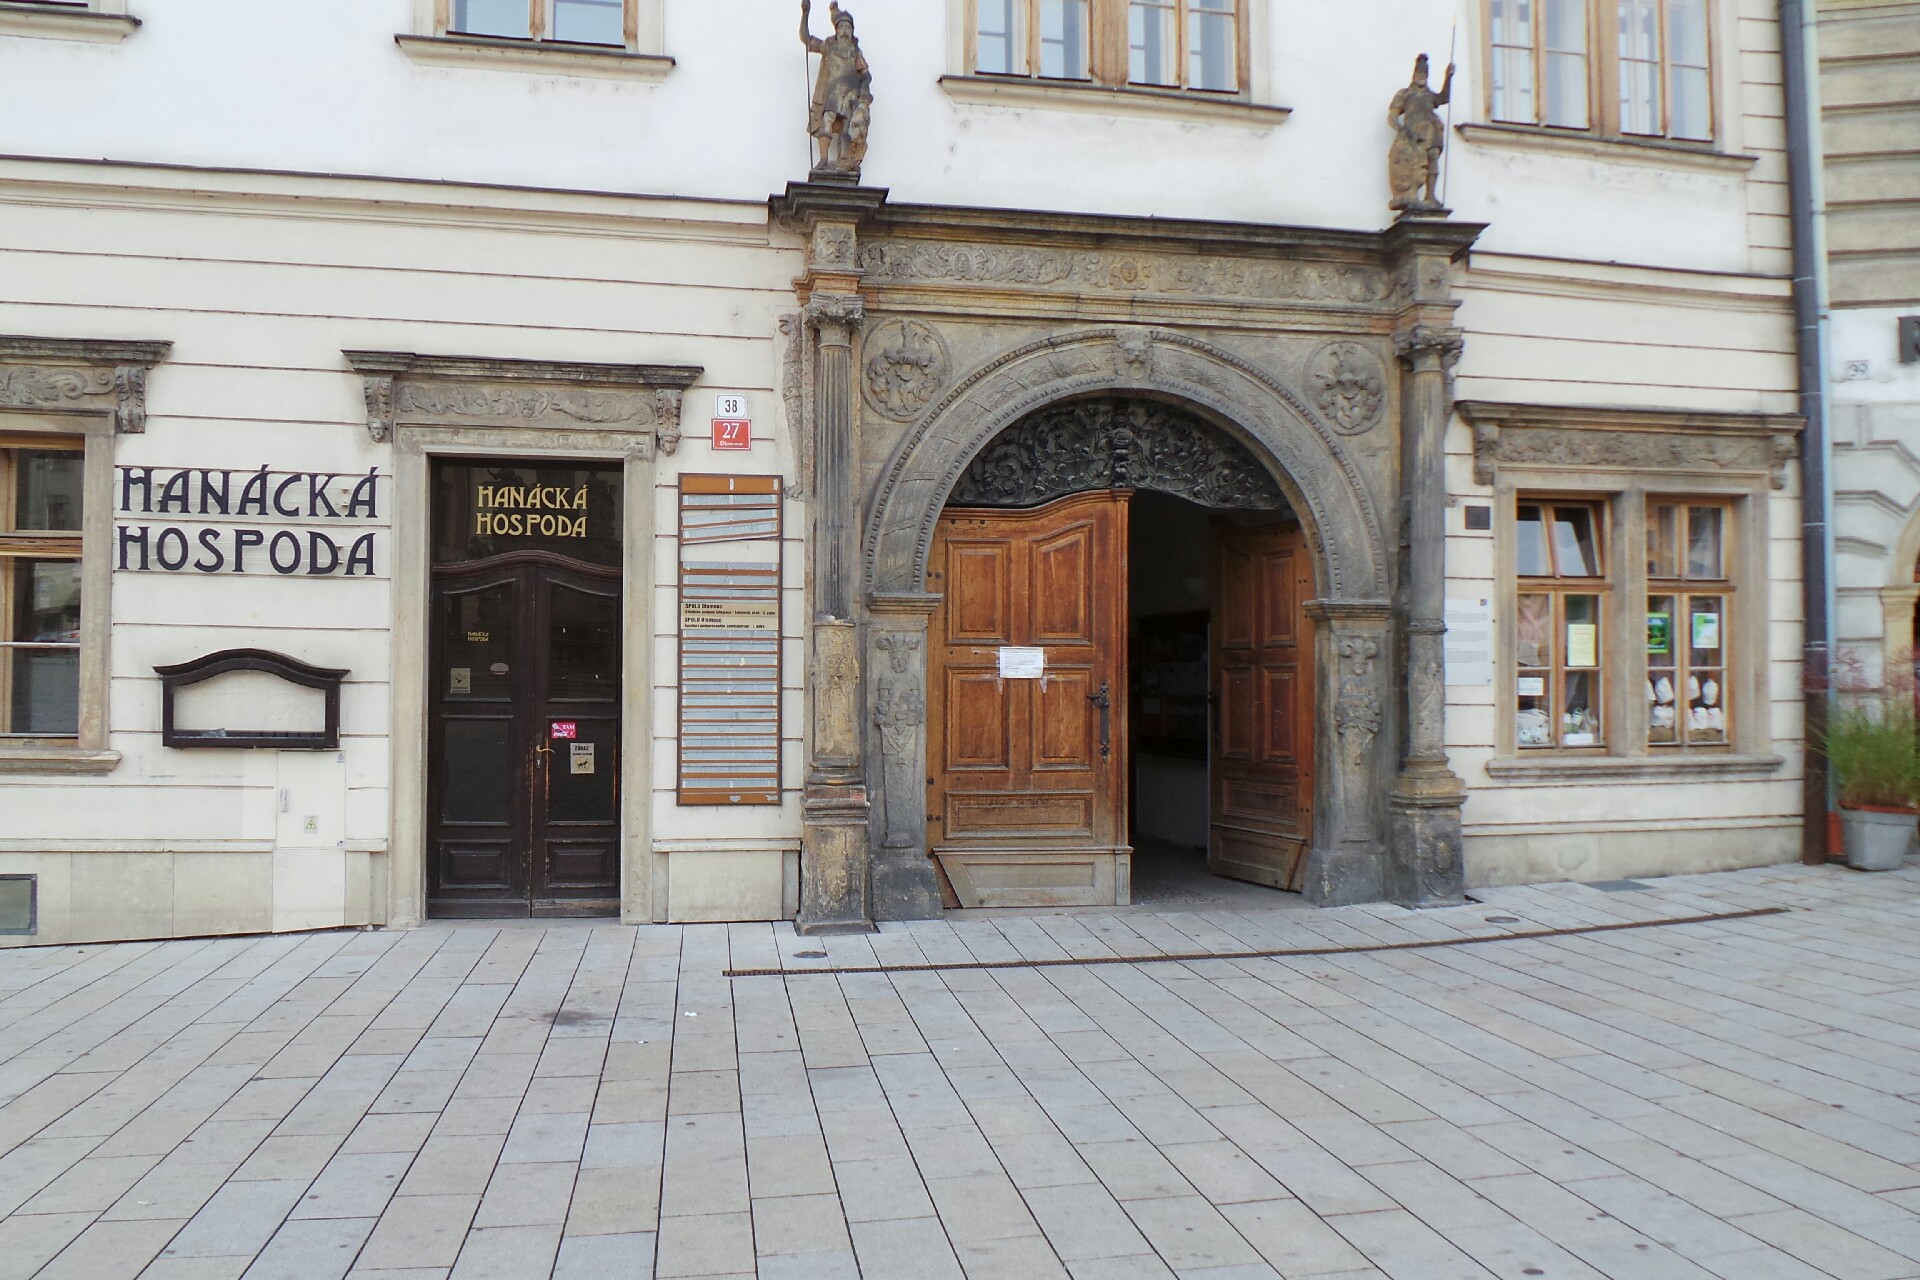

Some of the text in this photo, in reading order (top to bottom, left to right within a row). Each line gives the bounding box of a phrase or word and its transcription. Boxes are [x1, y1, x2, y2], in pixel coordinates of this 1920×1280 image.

[724, 399, 738, 413] 38
[722, 422, 740, 439] 27
[120, 464, 379, 518] HANÁCKÁ
[477, 483, 588, 509] HANÁCKÁ
[476, 512, 588, 538] HOSPODA
[117, 526, 376, 575] HOSPODA
